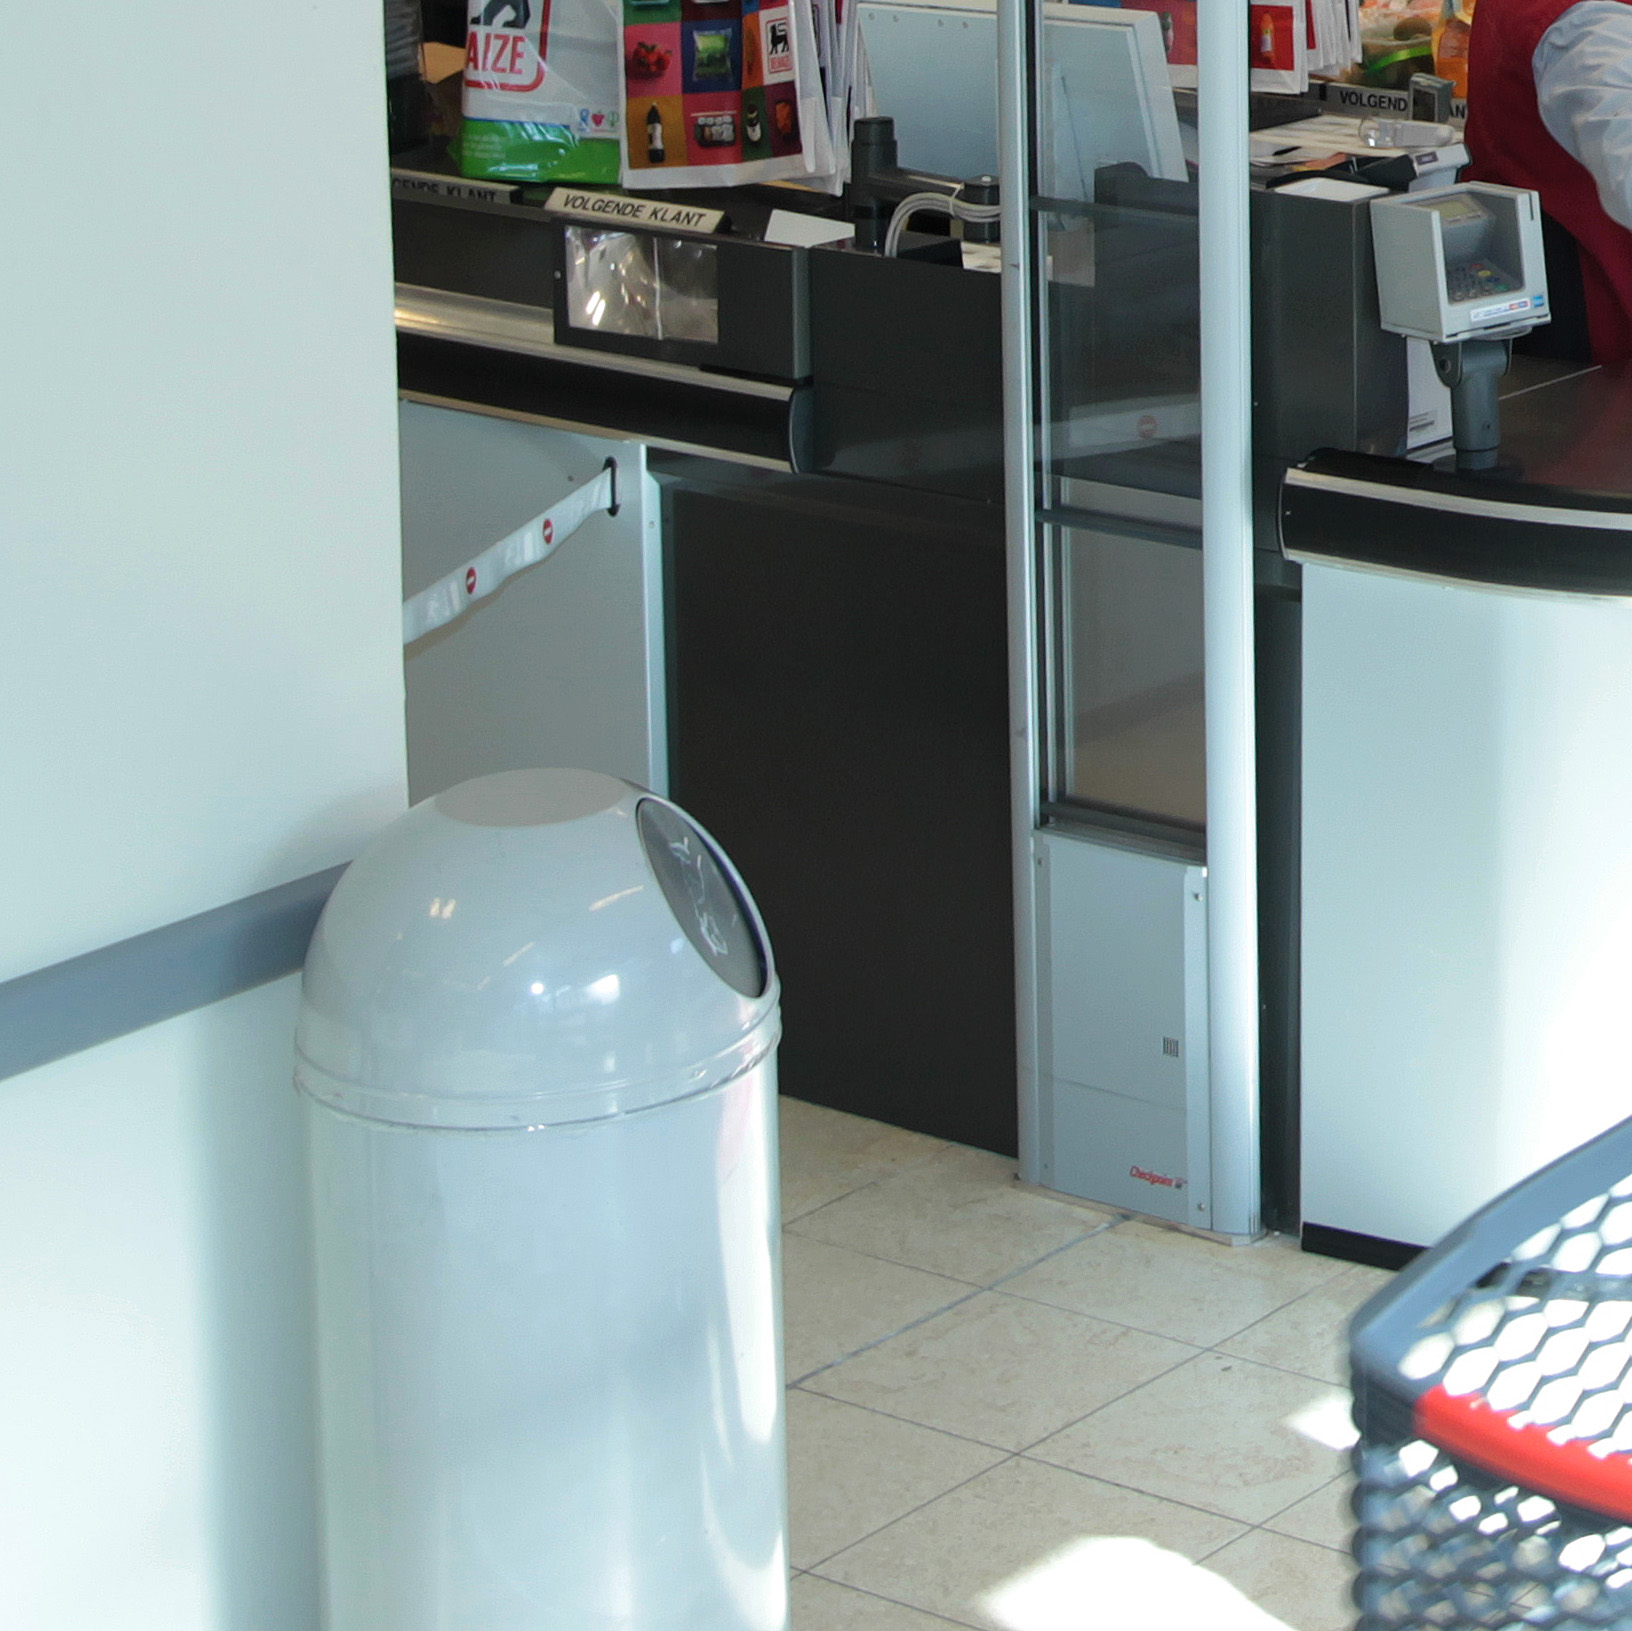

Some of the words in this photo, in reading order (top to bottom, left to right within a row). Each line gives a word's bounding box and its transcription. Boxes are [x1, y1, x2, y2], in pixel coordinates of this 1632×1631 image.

[1340, 90, 1408, 113] VOLGEND
[563, 193, 646, 219] VOLGENDE
[647, 206, 707, 228] KLANT
